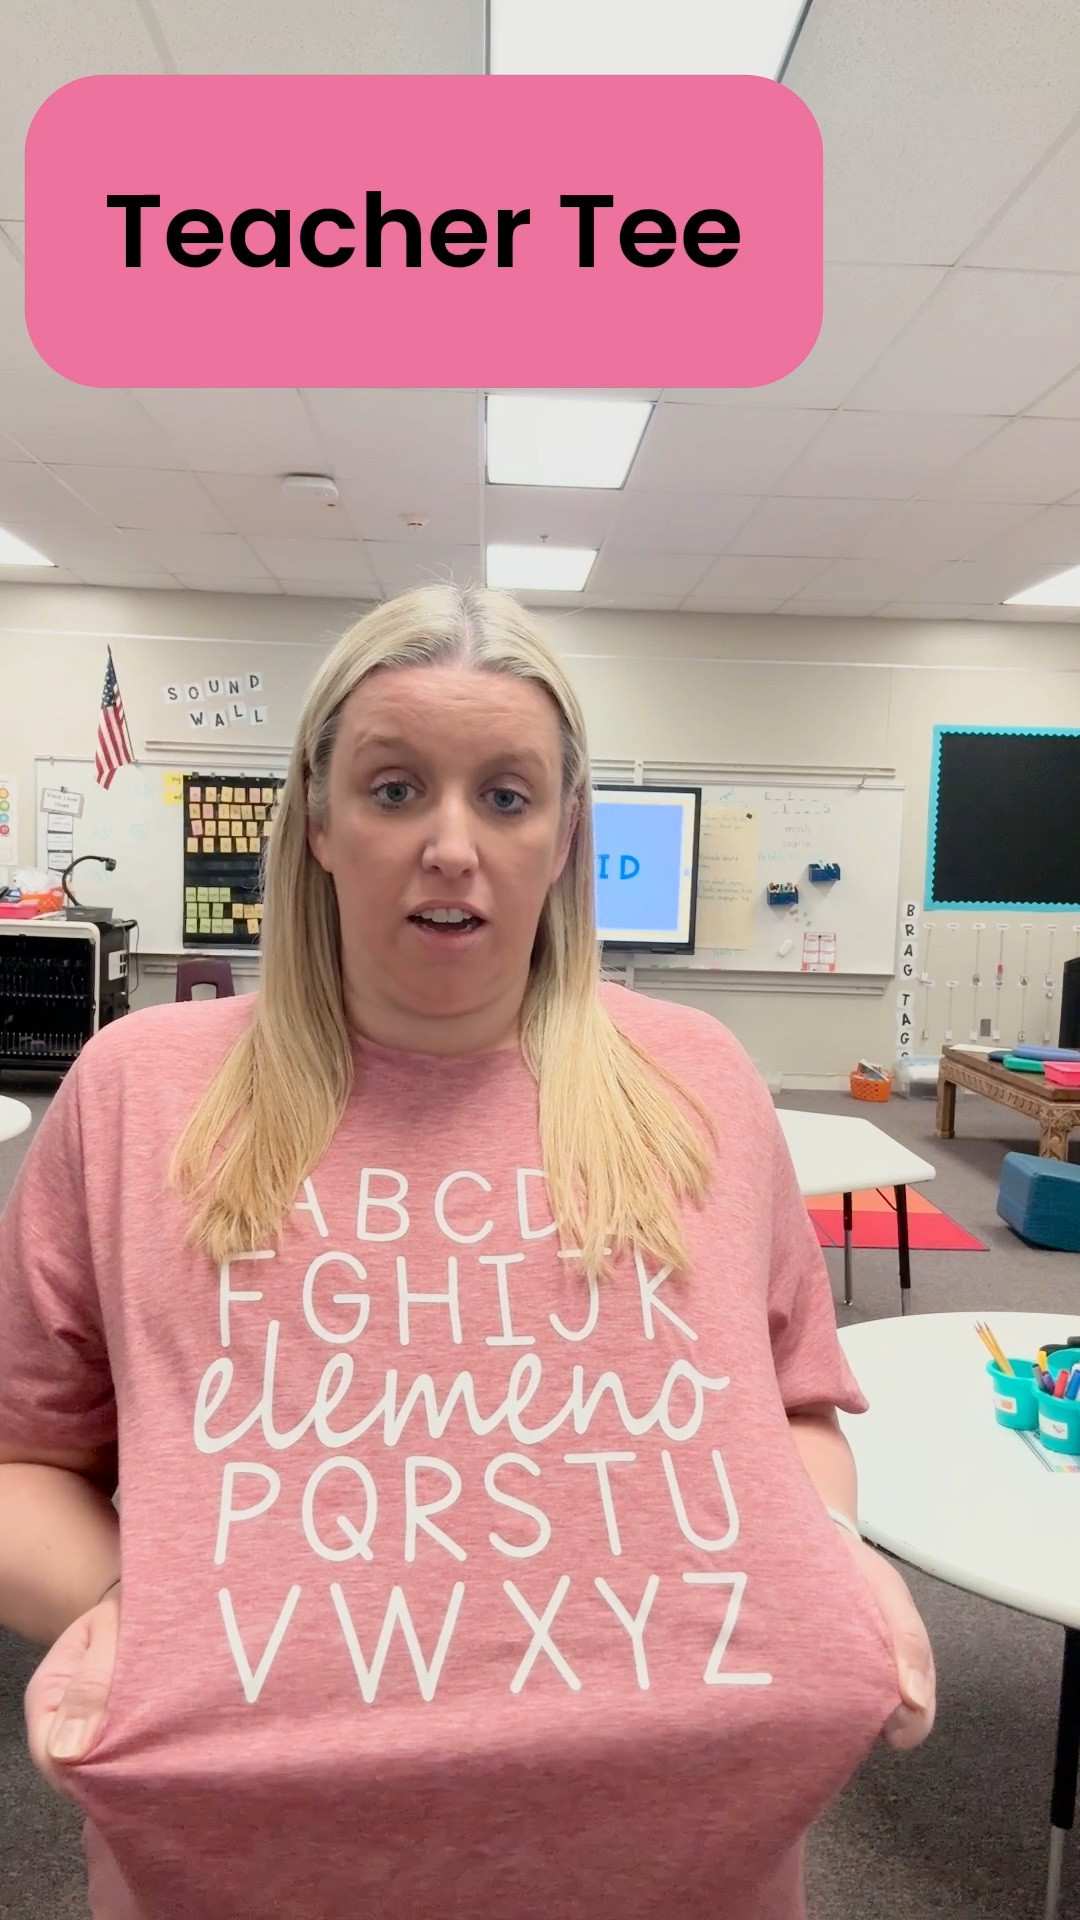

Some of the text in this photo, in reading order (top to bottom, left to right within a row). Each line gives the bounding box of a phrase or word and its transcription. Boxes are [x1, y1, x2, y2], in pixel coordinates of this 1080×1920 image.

[167, 674, 260, 701] SOUND
[189, 704, 263, 727] WALL
[903, 903, 916, 977] BRAG
[194, 1321, 731, 1454] elemeno
[214, 1450, 741, 1567] PQRSTU
[218, 1572, 773, 1704] VWXYZ
